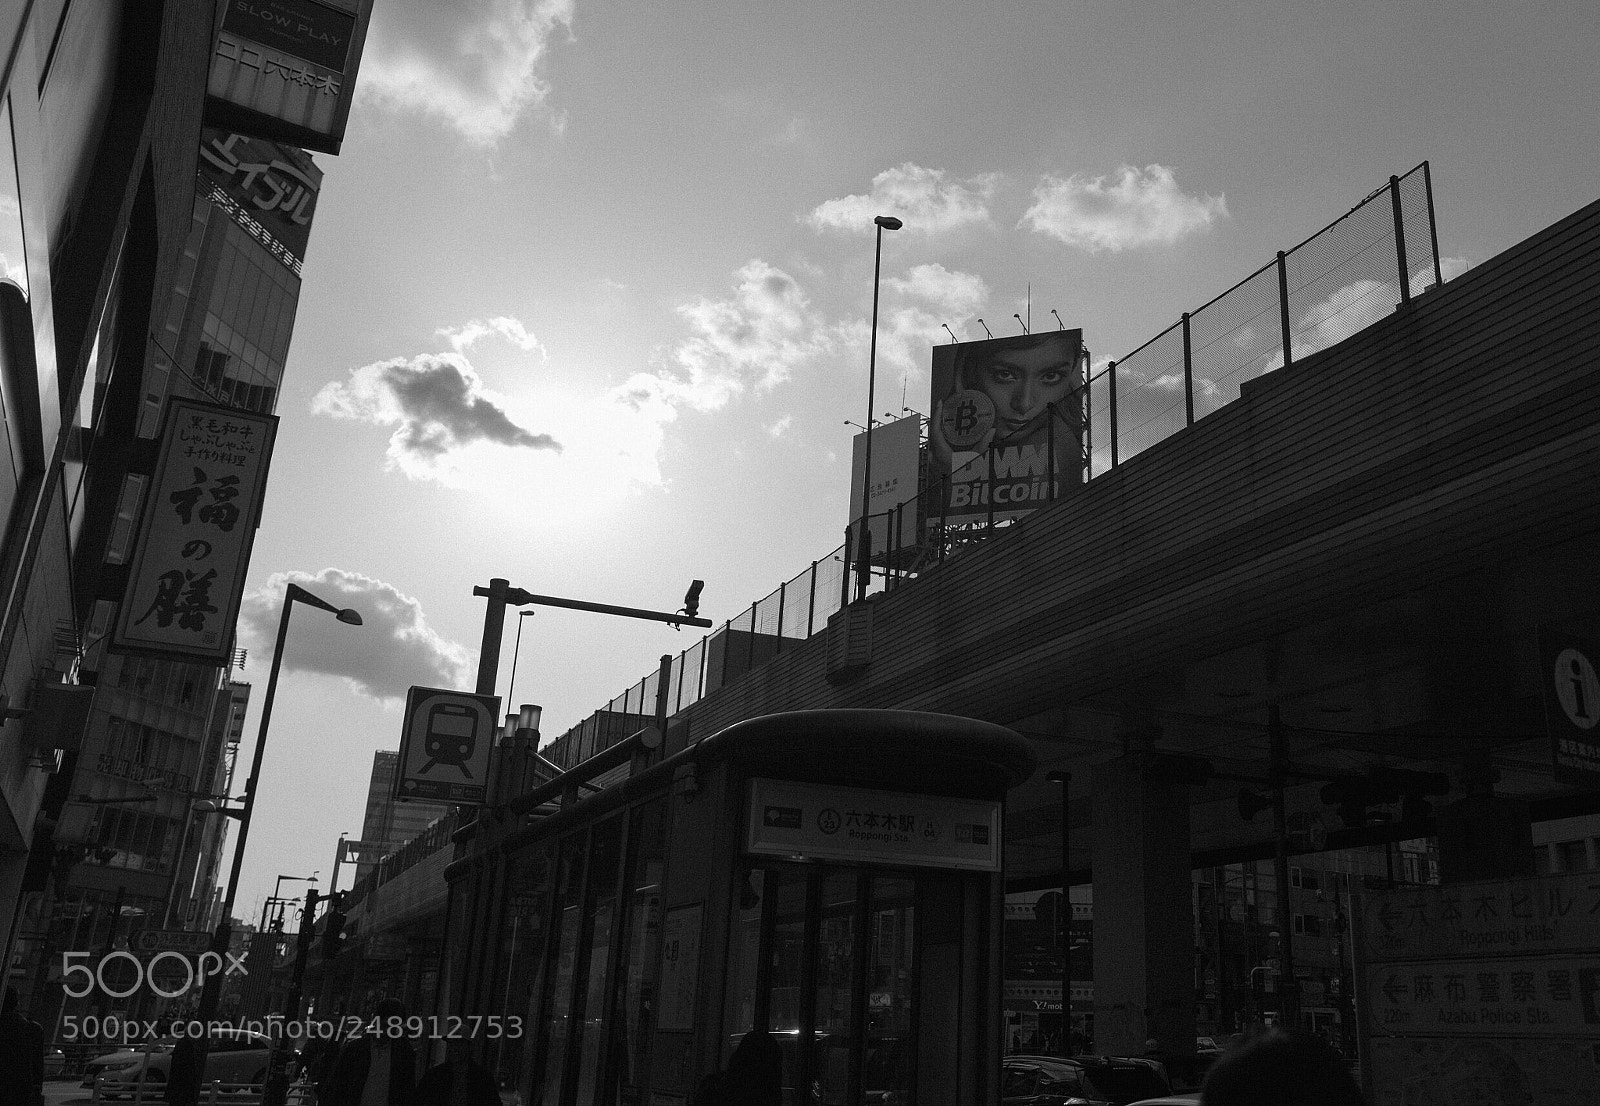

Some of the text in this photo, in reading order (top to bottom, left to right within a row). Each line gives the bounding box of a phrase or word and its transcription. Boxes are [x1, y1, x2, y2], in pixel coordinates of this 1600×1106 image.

[236, 1, 292, 28] SLOW
[297, 23, 342, 46] PLAY
[187, 416, 254, 438] 黒毛和牛
[184, 446, 247, 467] 手作り料理
[950, 477, 1059, 508] Bitcoin
[846, 810, 915, 833] 六本木駅
[849, 829, 892, 843] Roppongi
[1460, 924, 1555, 948] Roppongi Hills
[1413, 968, 1572, 1003] 麻布警察署
[1438, 1007, 1477, 1024] Azabu
[1481, 1006, 1521, 1024] Police
